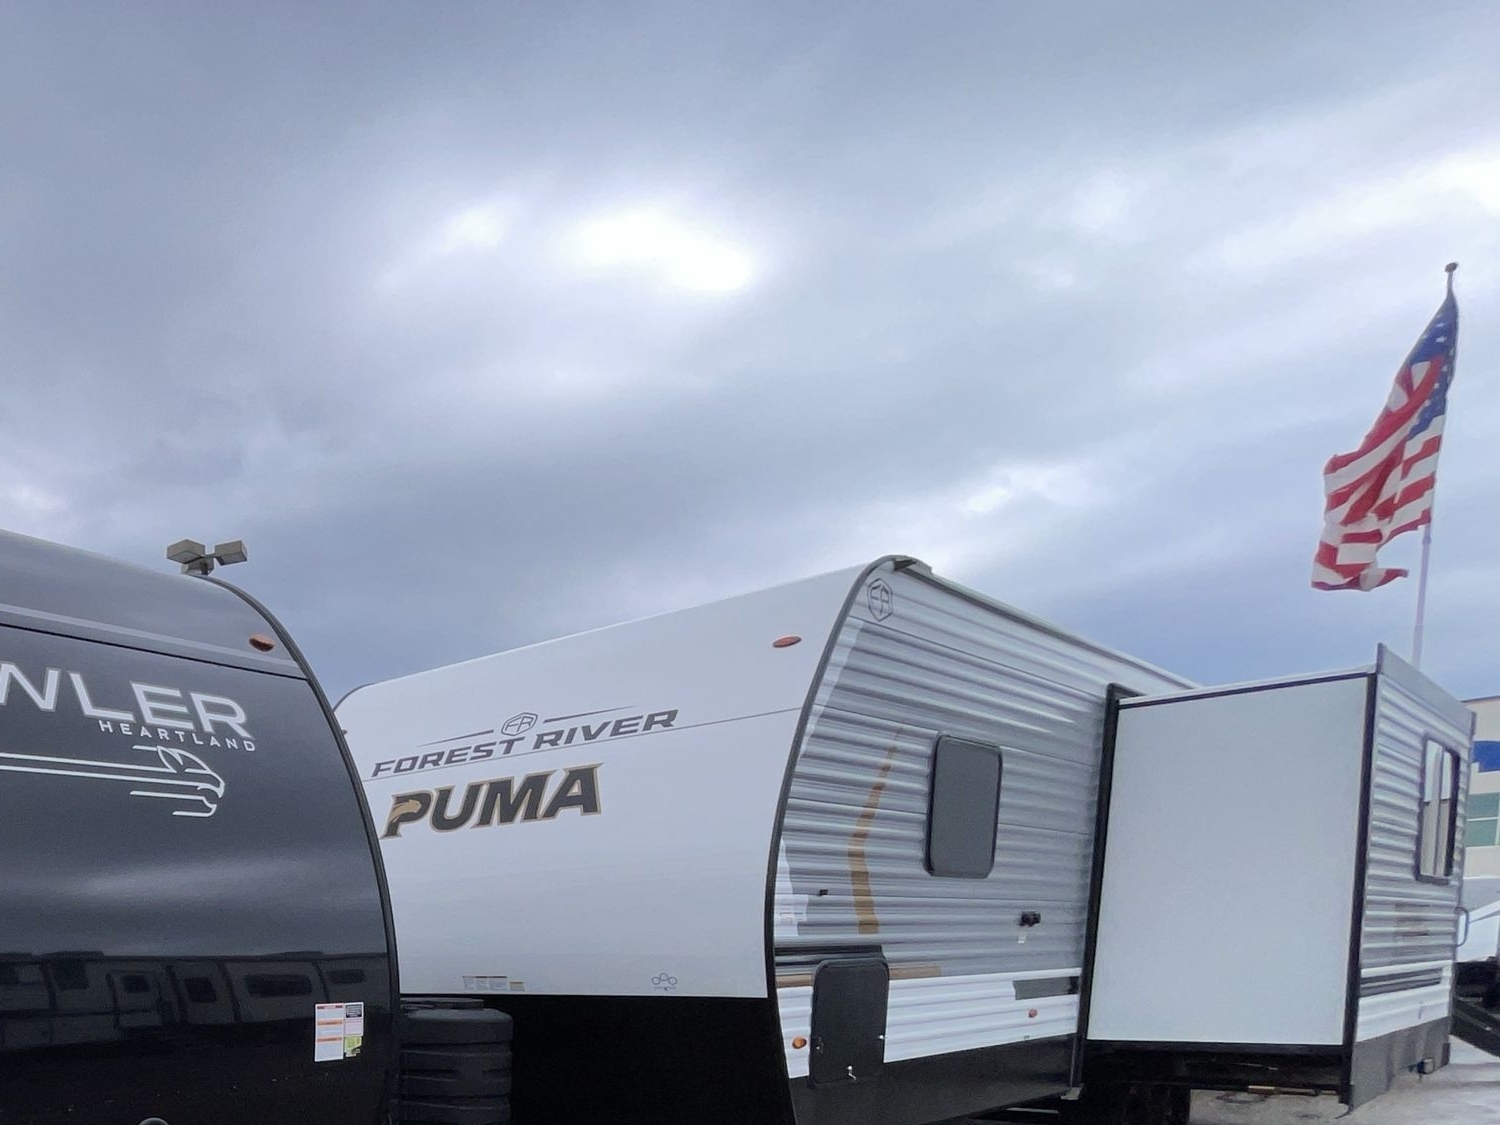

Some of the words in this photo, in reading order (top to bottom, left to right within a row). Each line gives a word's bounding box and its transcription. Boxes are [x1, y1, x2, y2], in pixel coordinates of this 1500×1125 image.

[98, 719, 256, 752] HEARTLAND
[371, 736, 526, 779] FOREST
[532, 708, 679, 751] RIVER
[378, 761, 605, 841] PUMA
